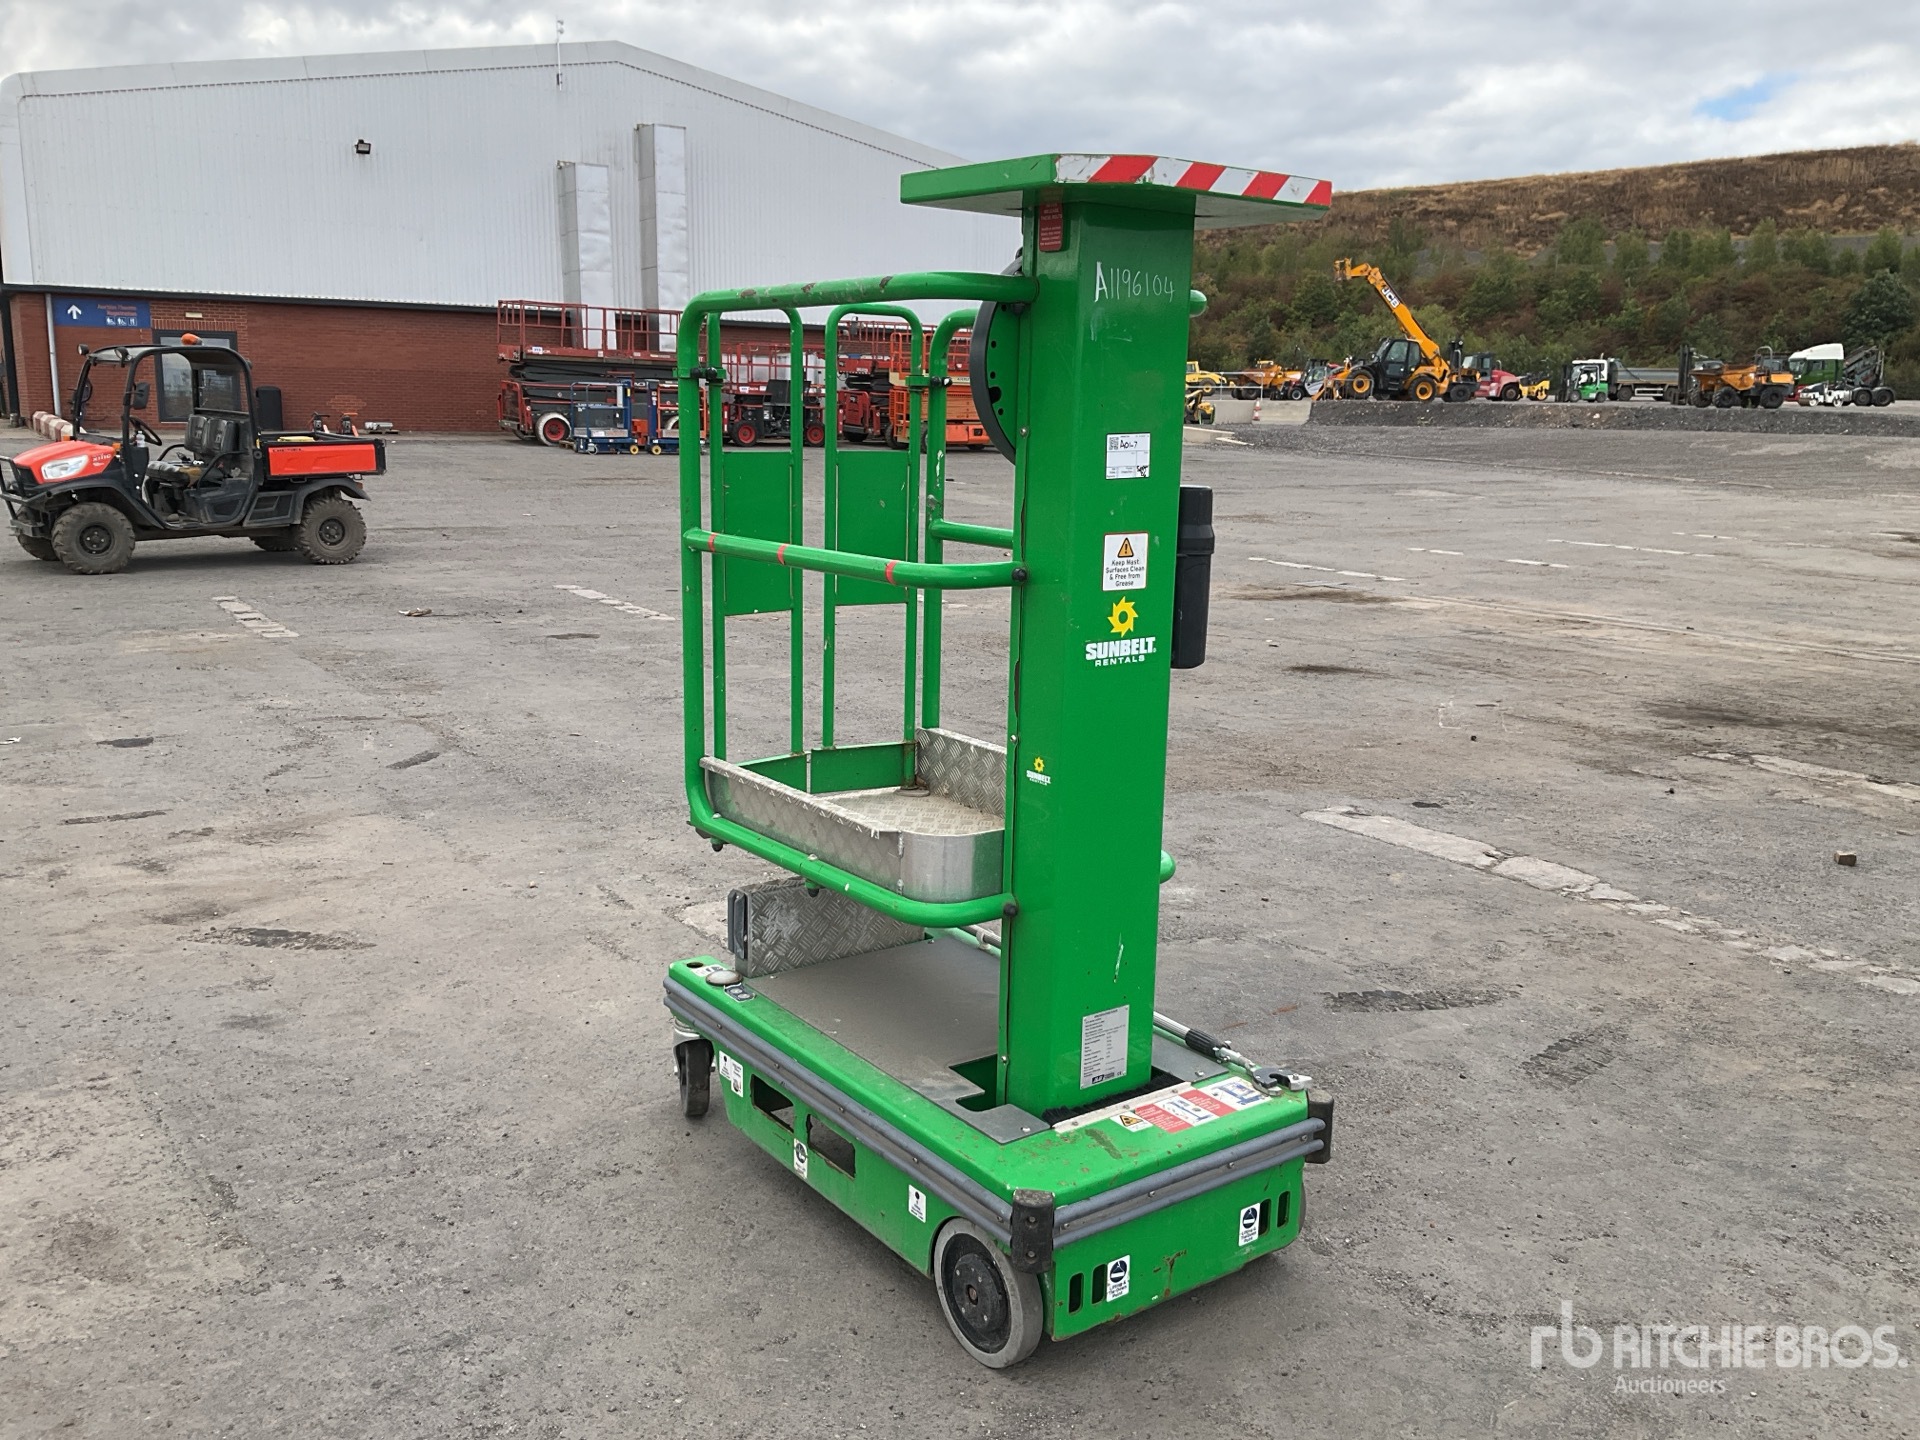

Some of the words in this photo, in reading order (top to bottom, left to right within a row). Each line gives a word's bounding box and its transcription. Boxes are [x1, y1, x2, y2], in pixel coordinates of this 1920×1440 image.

[1094, 261, 1176, 303] A1196104
[1382, 288, 1400, 308] JCB
[1105, 566, 1129, 574] Surfaces
[1085, 636, 1156, 660] SUNBELT
[1094, 654, 1146, 667] RENTALS
